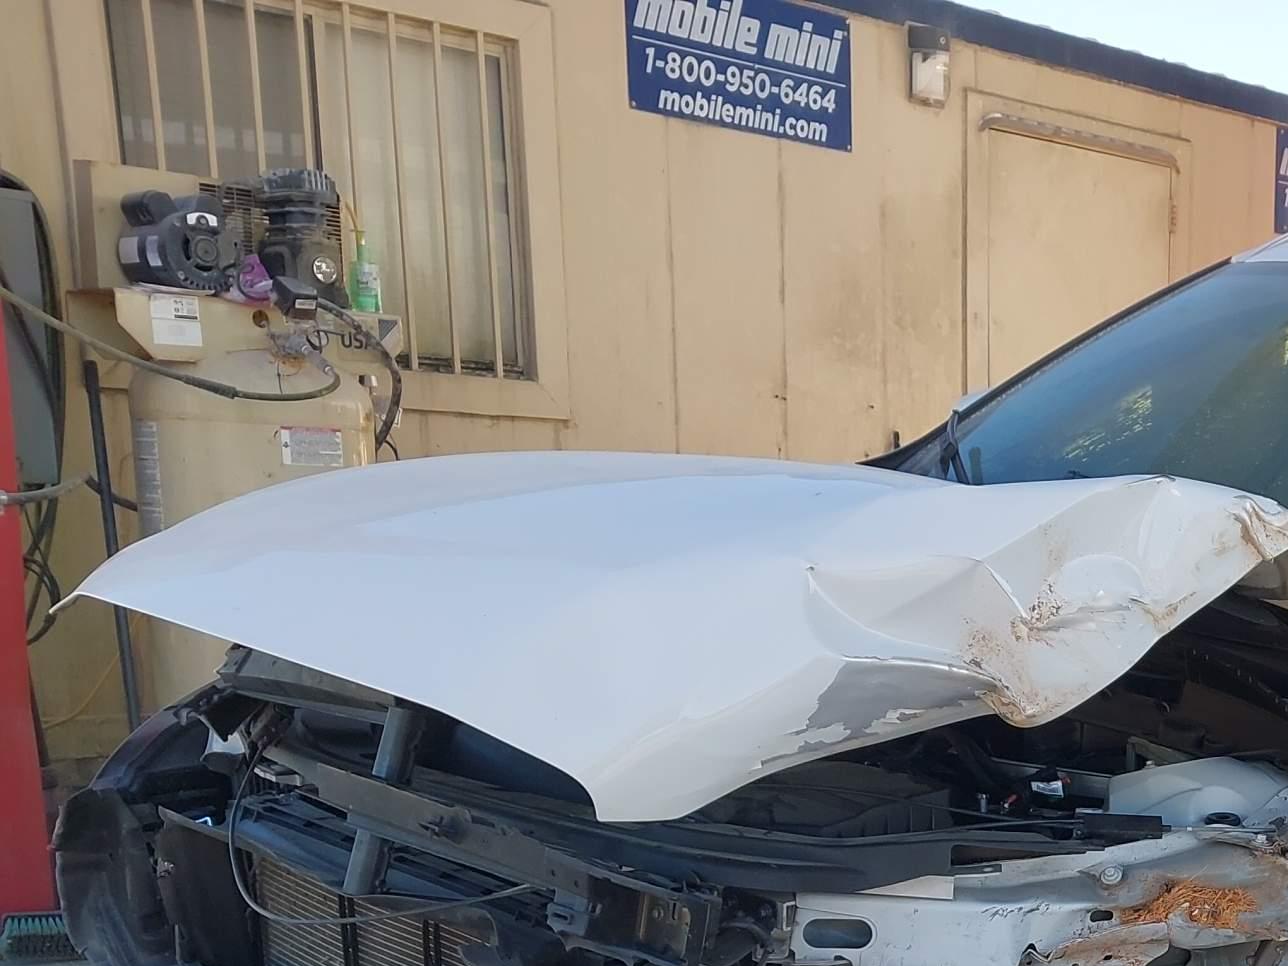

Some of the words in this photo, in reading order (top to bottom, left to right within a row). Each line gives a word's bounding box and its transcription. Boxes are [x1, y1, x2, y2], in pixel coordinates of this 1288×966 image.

[633, 0, 760, 55] mobile
[764, 21, 843, 74] mini
[645, 47, 836, 113] 1-800-950-6464
[658, 89, 828, 142] mobilemini.com
